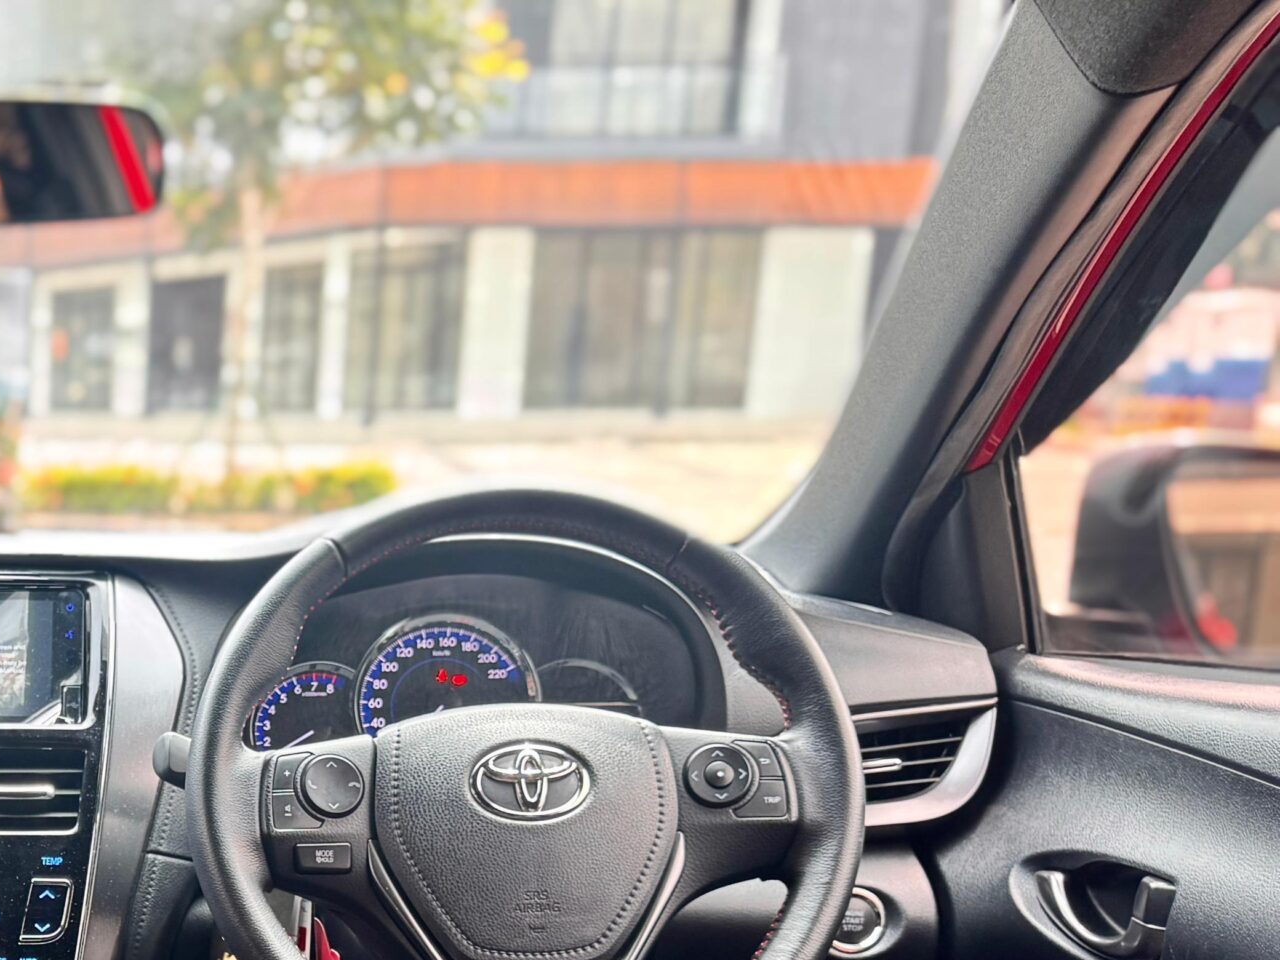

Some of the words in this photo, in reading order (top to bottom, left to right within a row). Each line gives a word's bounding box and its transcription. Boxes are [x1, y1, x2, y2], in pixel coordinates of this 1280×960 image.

[416, 639, 434, 649] 140
[439, 638, 457, 647] 160
[461, 642, 480, 652] 180
[396, 648, 414, 658] 120
[477, 654, 498, 663] 200
[381, 662, 399, 672] 100
[488, 670, 508, 679] 220
[294, 684, 302, 694] 6
[311, 682, 318, 691] 7
[326, 683, 334, 694] 8
[373, 679, 388, 689] 80
[280, 693, 287, 703] 5
[368, 698, 383, 708] 60
[268, 705, 276, 715] 4
[263, 720, 271, 730] 3
[371, 718, 386, 728] 40
[263, 737, 271, 747] 2
[41, 857, 63, 866] TEMP
[523, 890, 549, 900] SRS
[513, 902, 562, 913] AIRBAG
